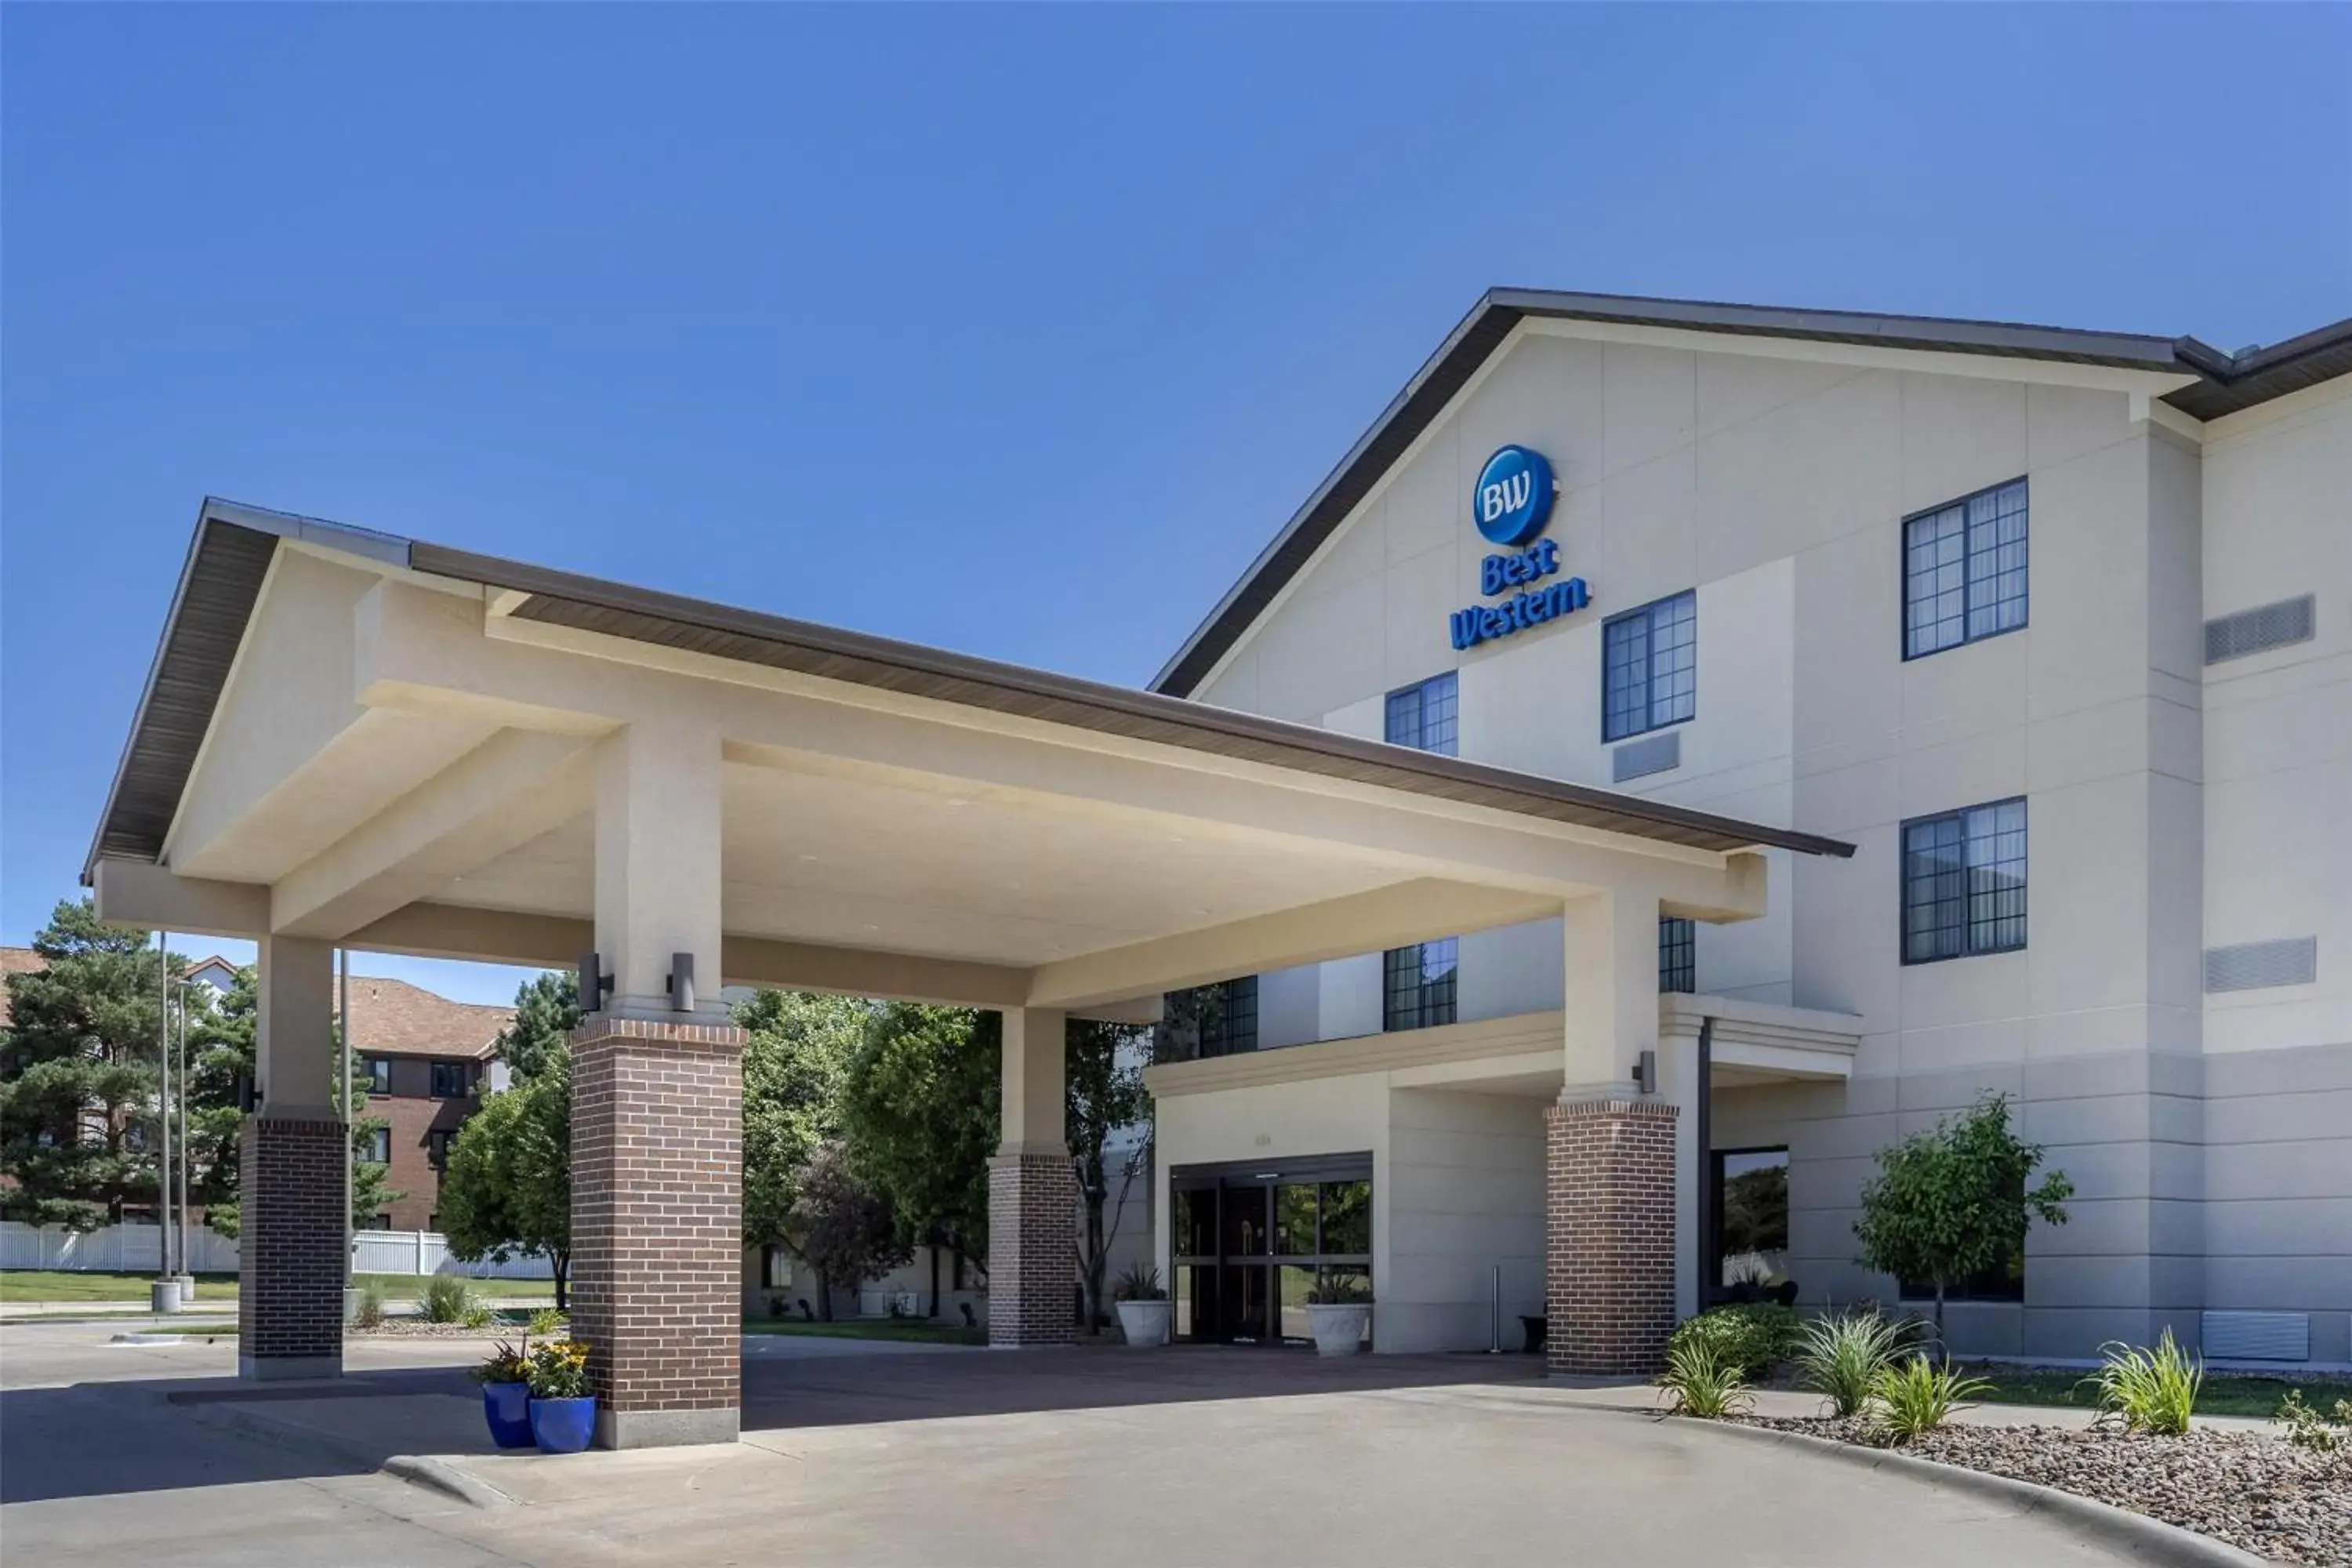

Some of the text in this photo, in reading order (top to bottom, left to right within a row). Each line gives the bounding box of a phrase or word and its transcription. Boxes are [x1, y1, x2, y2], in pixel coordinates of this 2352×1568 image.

[1483, 470, 1530, 522] BW
[1481, 539, 1559, 596] Best
[1450, 577, 1588, 650] Western
